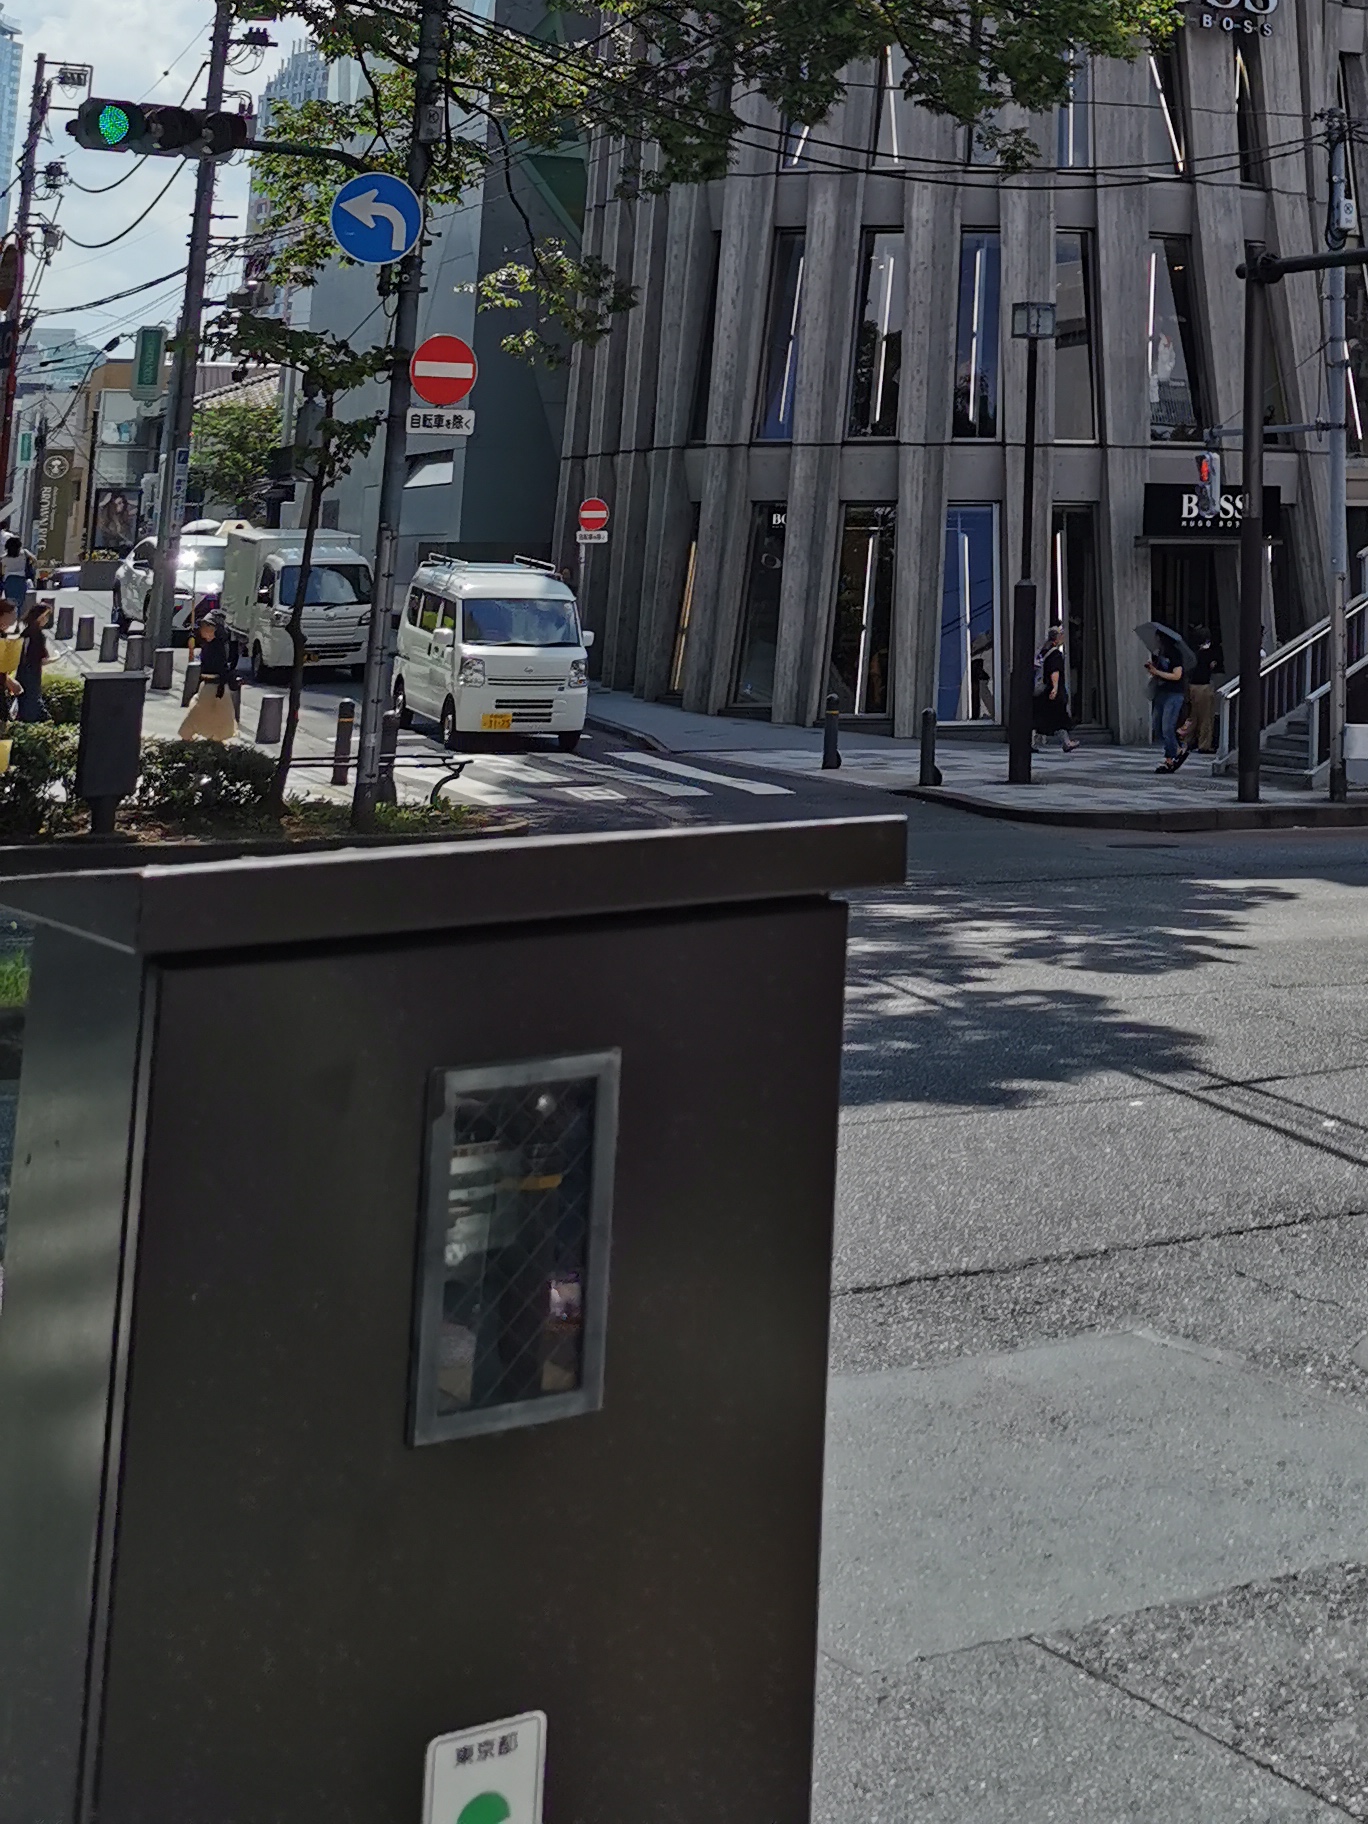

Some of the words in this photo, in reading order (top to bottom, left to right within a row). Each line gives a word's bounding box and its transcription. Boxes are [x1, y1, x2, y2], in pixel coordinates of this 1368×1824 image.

[1202, 14, 1273, 37] BOSS
[410, 412, 472, 431] 自転車を除く
